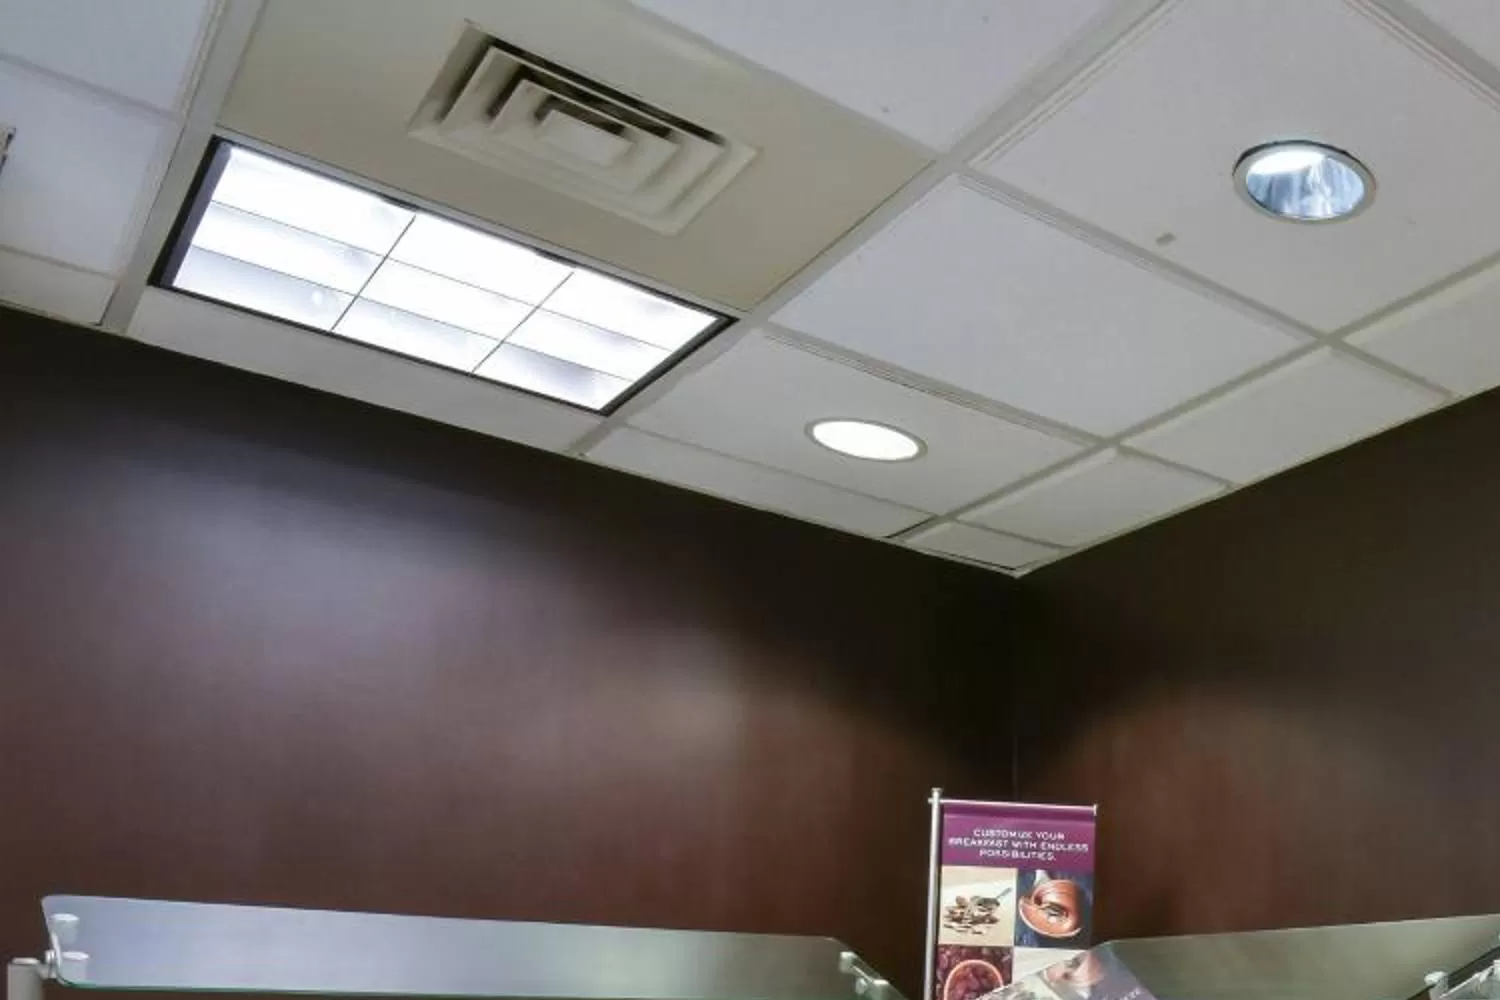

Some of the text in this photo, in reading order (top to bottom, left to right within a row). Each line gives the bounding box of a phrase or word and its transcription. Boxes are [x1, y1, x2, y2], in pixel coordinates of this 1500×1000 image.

[973, 827, 1065, 840] CUSTOMIZE YOUR
[948, 837, 1089, 852] BREAKFAST WITH ENDLESS
